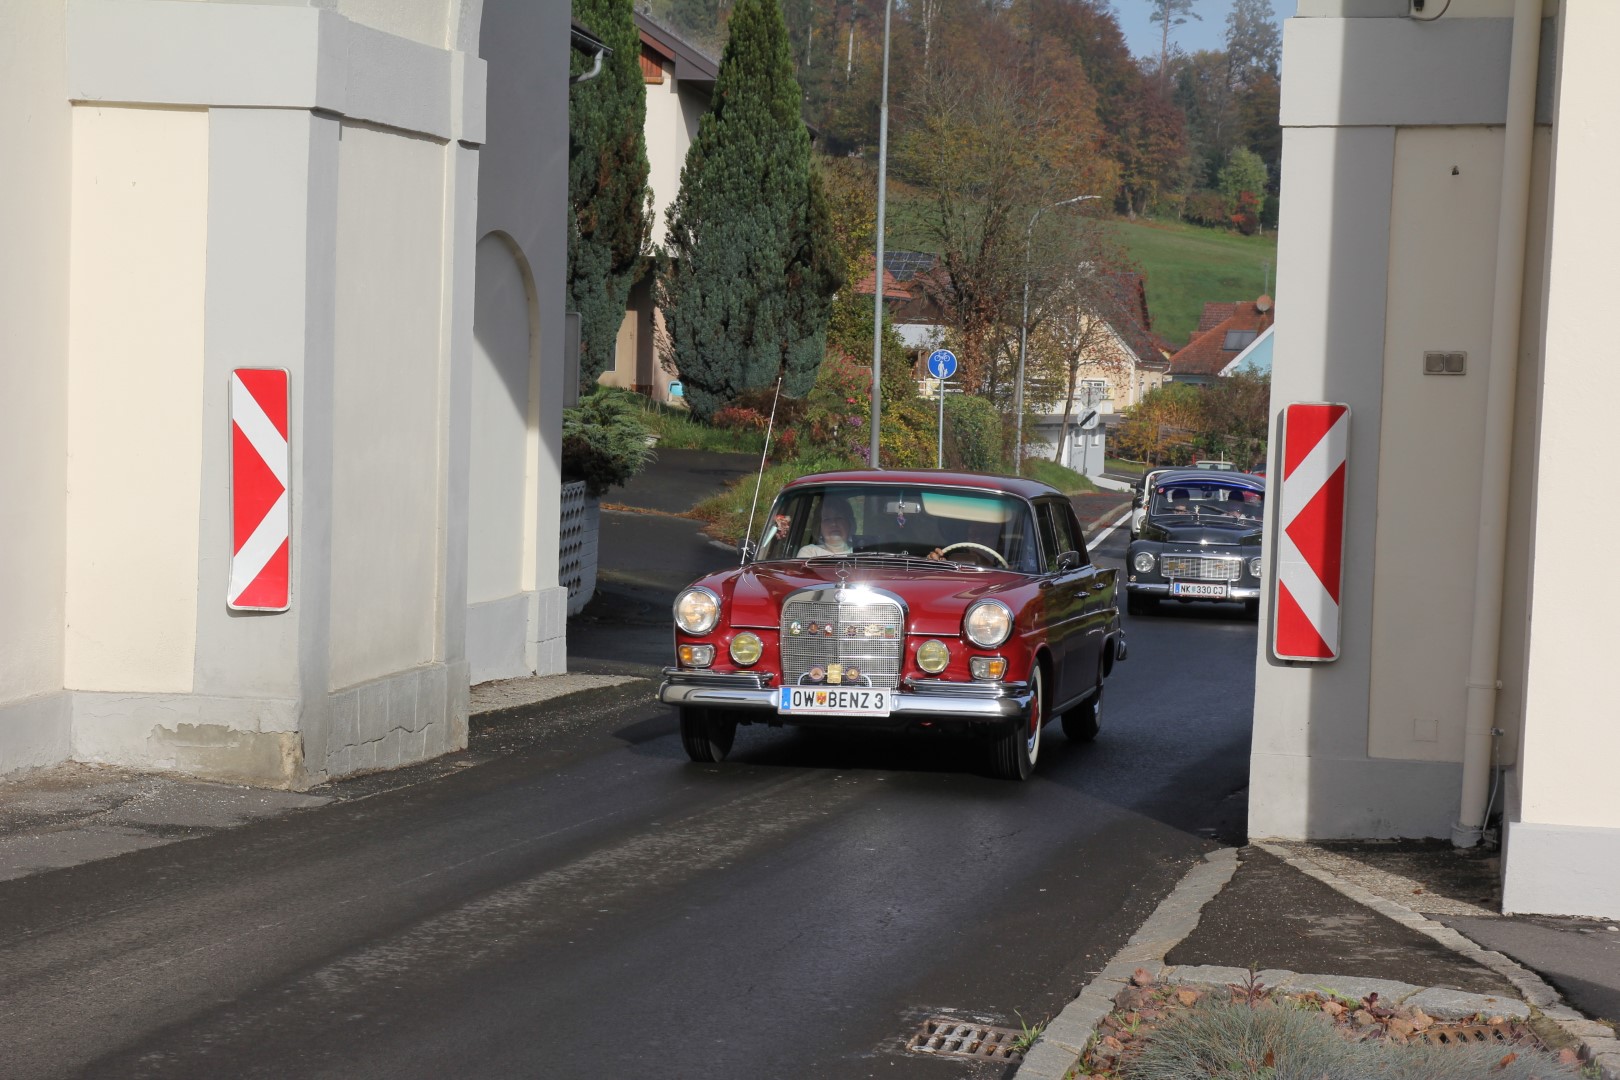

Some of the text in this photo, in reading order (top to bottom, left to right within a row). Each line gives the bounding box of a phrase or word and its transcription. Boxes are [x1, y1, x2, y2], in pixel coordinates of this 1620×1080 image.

[1181, 585, 1191, 593] NK
[1196, 586, 1212, 594] 330
[1213, 586, 1224, 595] CJ
[793, 690, 884, 709] OW BENZ 3
